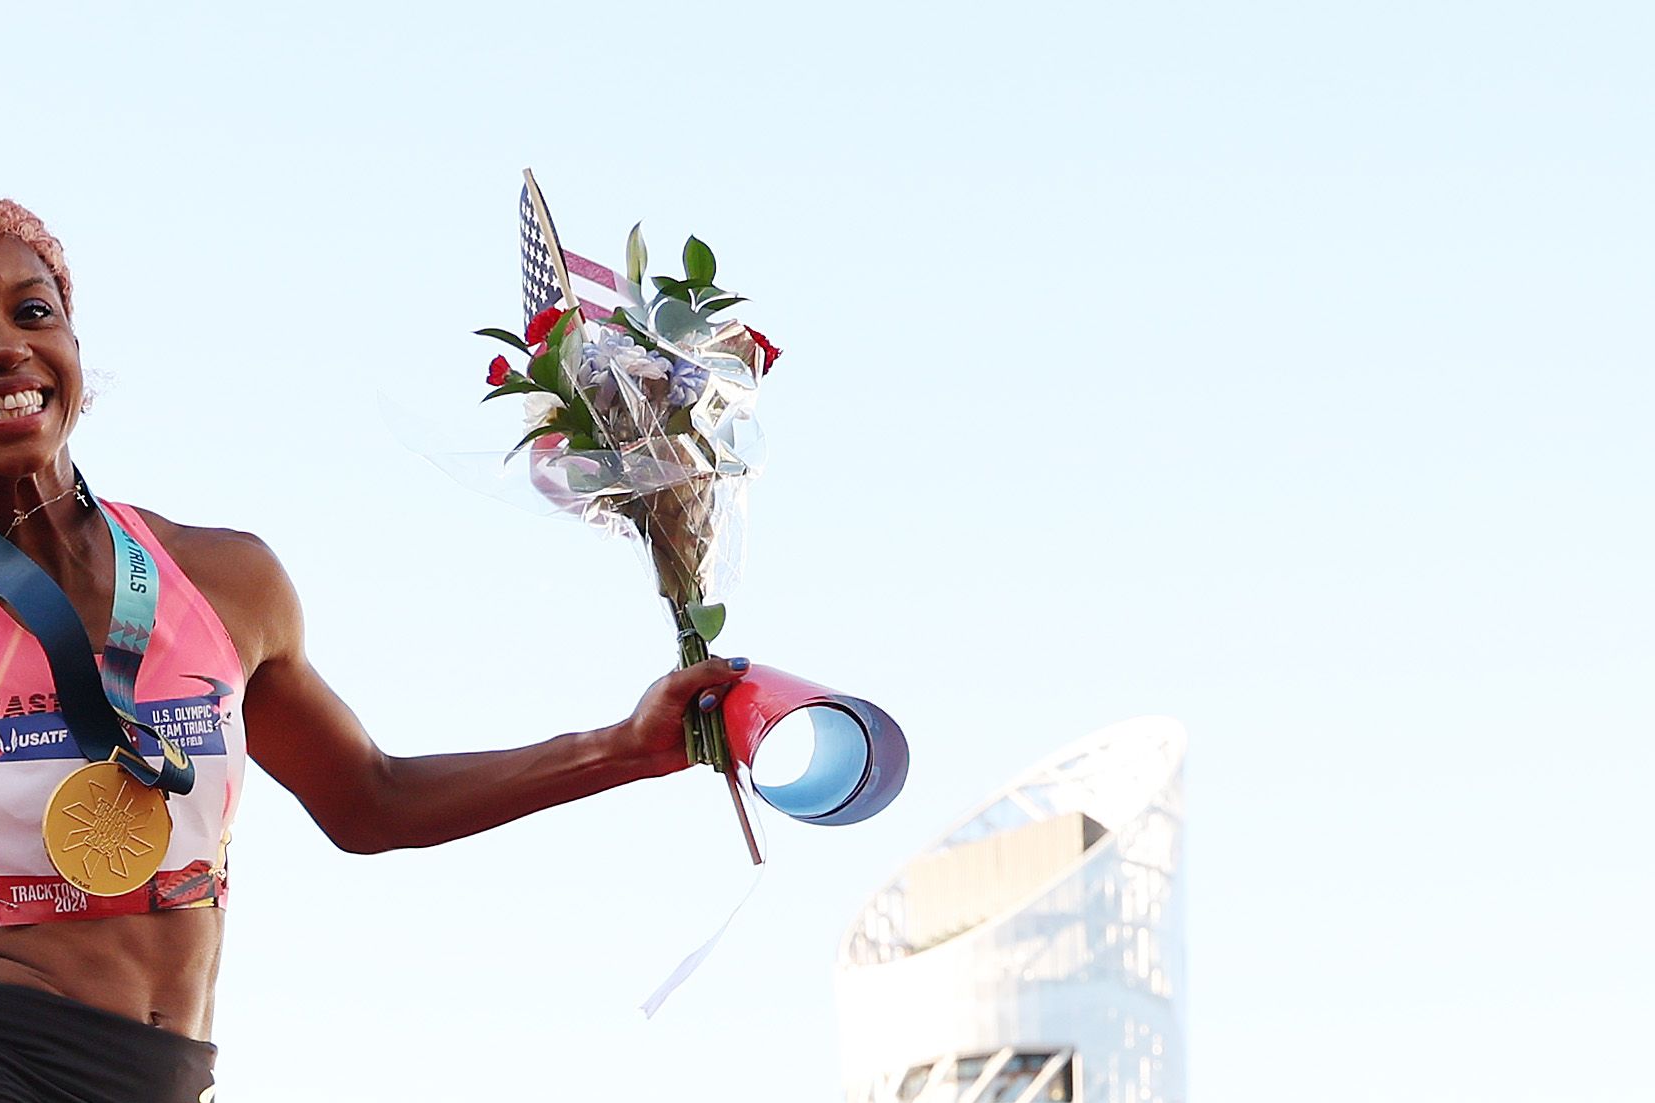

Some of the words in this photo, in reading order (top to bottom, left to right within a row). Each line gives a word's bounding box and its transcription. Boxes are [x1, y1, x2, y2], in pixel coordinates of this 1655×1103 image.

[128, 545, 147, 594] TRIALS
[152, 708, 173, 724] U.S.
[175, 705, 212, 721] OLYMPIC
[153, 722, 182, 737] TEAM
[183, 720, 214, 735] TRIALS
[18, 730, 68, 747] USATF
[186, 735, 203, 747] FIELD
[54, 894, 88, 913] 2024
